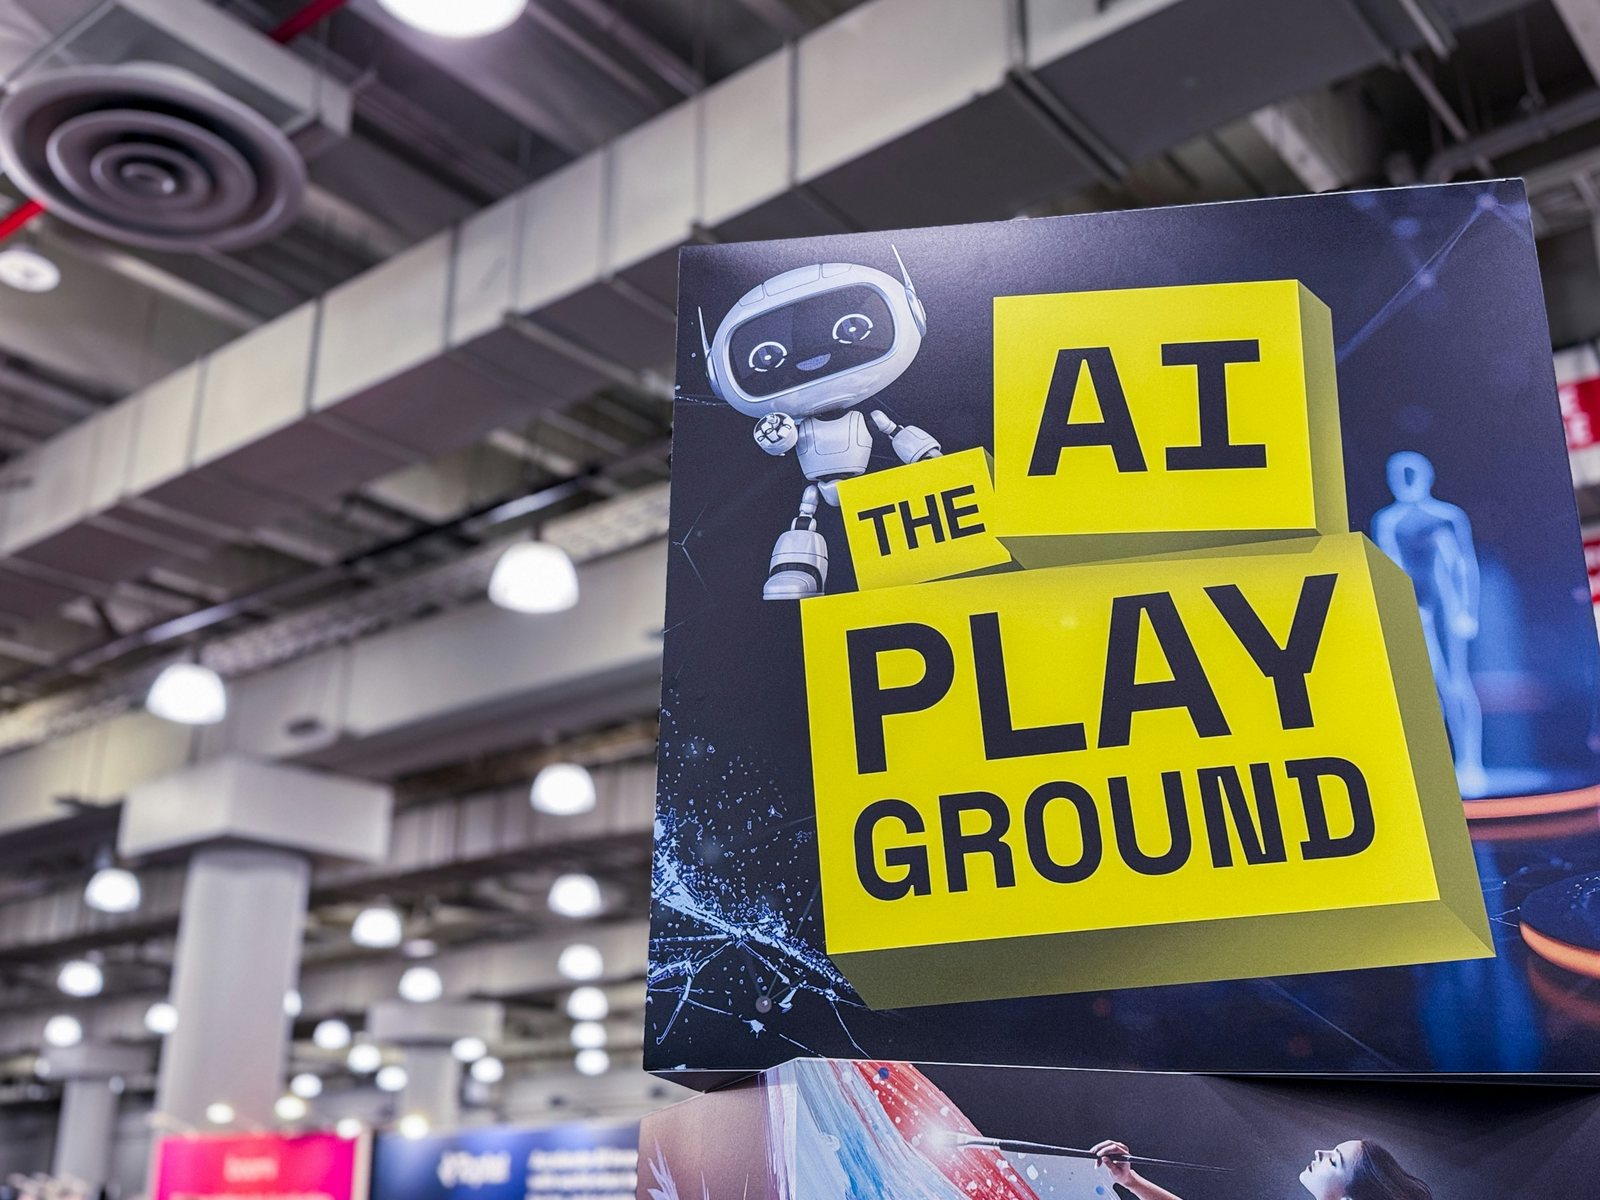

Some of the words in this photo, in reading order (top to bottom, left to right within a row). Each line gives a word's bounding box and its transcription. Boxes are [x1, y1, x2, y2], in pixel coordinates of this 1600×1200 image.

[1027, 339, 1267, 477] AI
[857, 484, 986, 557] THE
[845, 573, 1339, 775] PLAY
[853, 756, 1376, 902] GROUND
